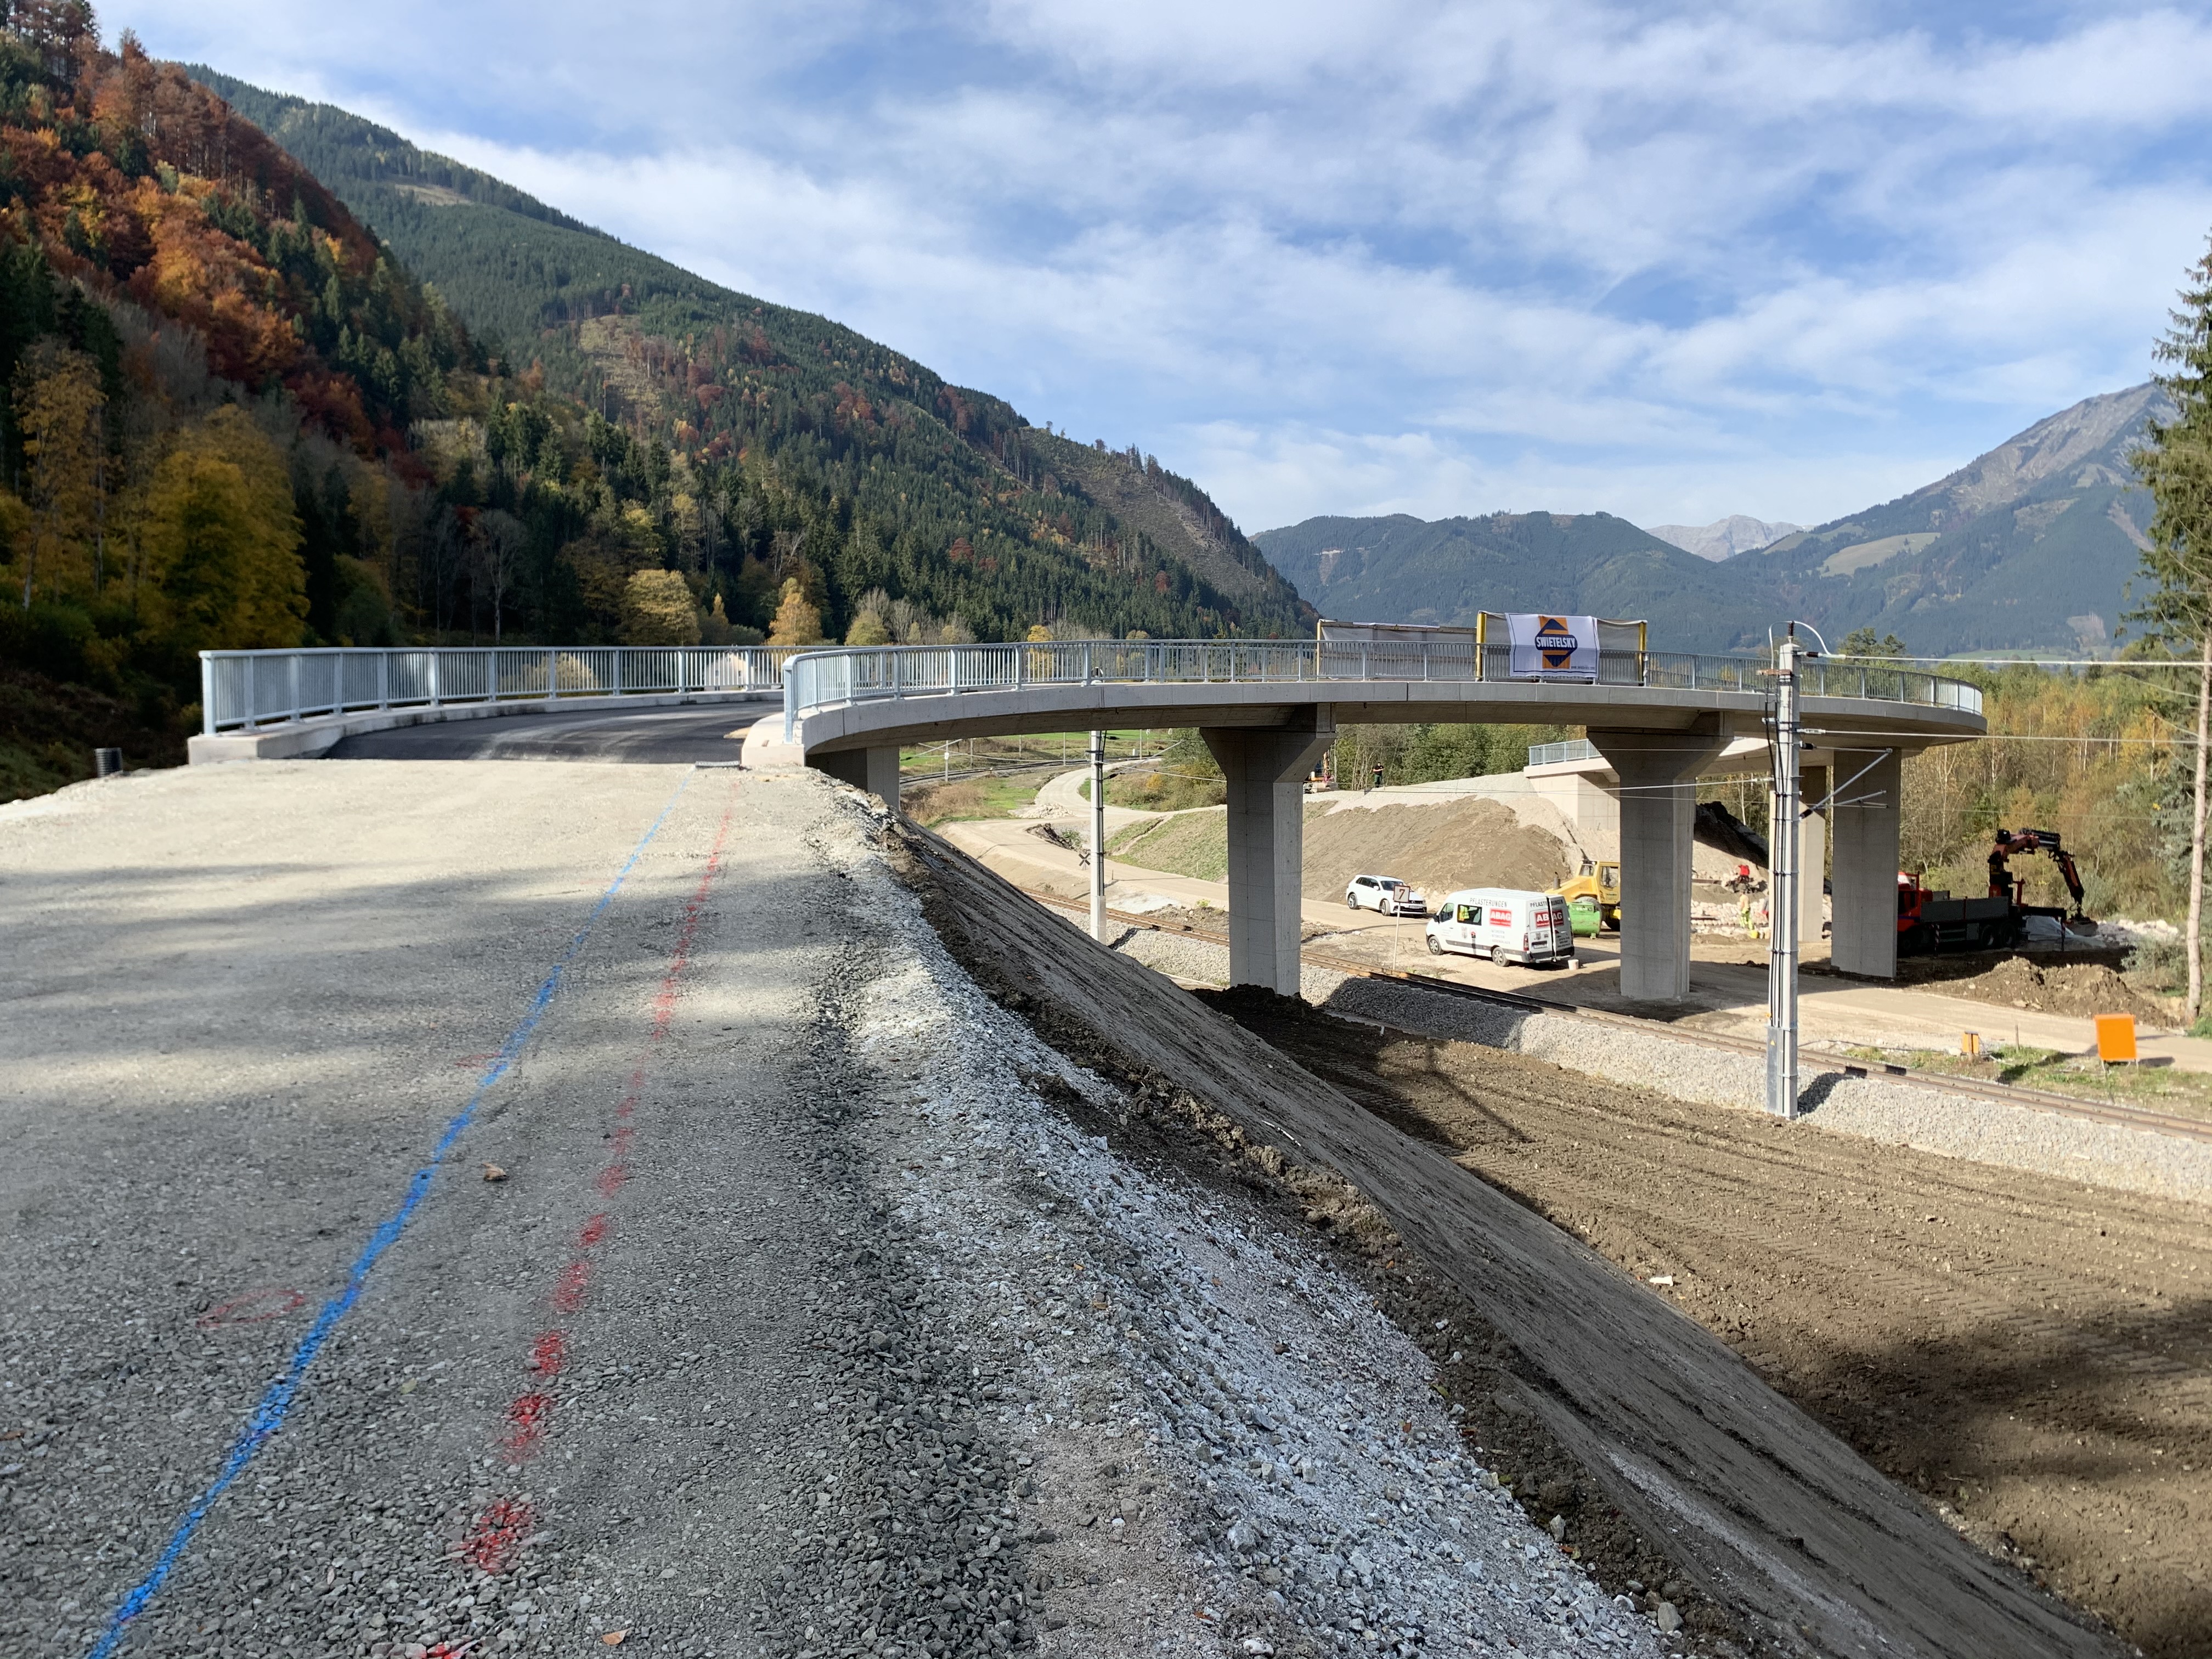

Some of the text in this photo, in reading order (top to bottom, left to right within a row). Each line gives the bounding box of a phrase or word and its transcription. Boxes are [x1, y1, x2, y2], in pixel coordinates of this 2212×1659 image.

[1537, 636, 1576, 648] SWIETELSKY
[1399, 889, 1406, 900] 7
[1470, 898, 1508, 908] PFLASTERUNGEN
[1490, 911, 1511, 921] ABAG
[1537, 912, 1563, 922] ABAG
